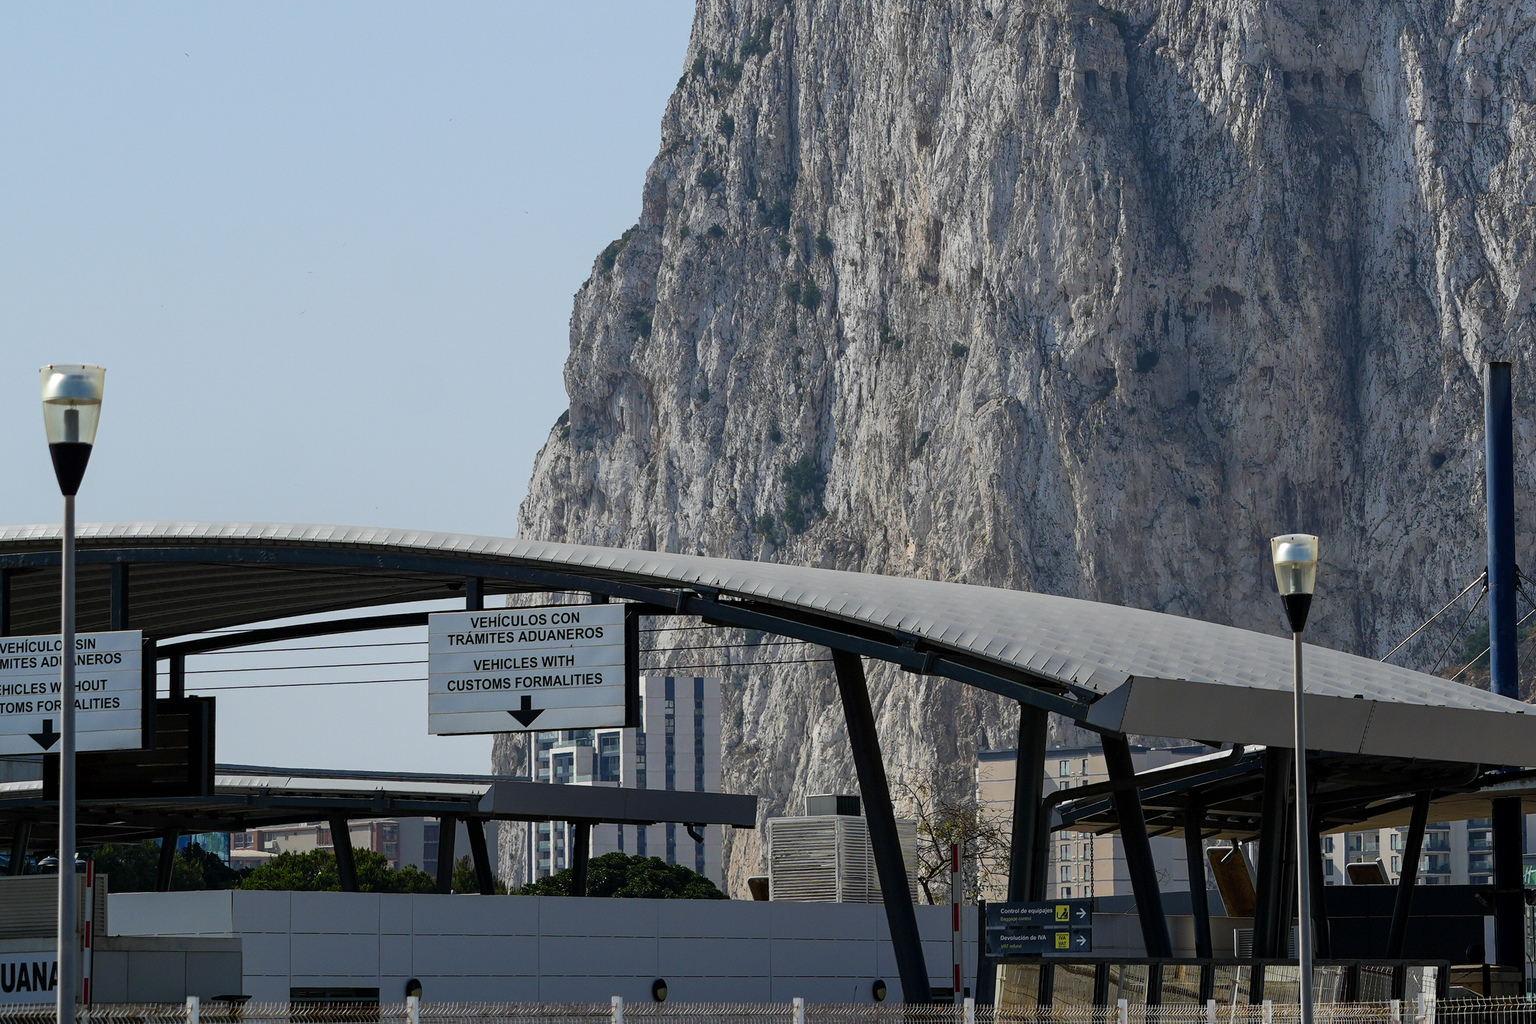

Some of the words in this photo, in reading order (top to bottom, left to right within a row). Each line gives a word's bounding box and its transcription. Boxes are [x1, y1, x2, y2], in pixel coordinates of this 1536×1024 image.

[471, 614, 547, 629] VEHÍCULOS
[551, 612, 580, 625] CON
[448, 631, 514, 646] TRÁMITES
[518, 627, 604, 643] ADUANEROS
[0, 639, 62, 654] VEHÍCULO
[75, 638, 96, 650] SIN
[0, 657, 37, 669] MITES
[41, 653, 122, 668] ADNEROS
[473, 657, 538, 671] VEHICLES
[541, 655, 575, 668] WITH
[0, 682, 47, 696] HICLES
[50, 679, 108, 693] WHOUT
[447, 678, 511, 692] CUSTOMS
[515, 673, 603, 689] FORMALITIES
[0, 701, 33, 714] TOMS
[37, 697, 120, 712] FORALITIES
[1, 961, 58, 994] UANA
